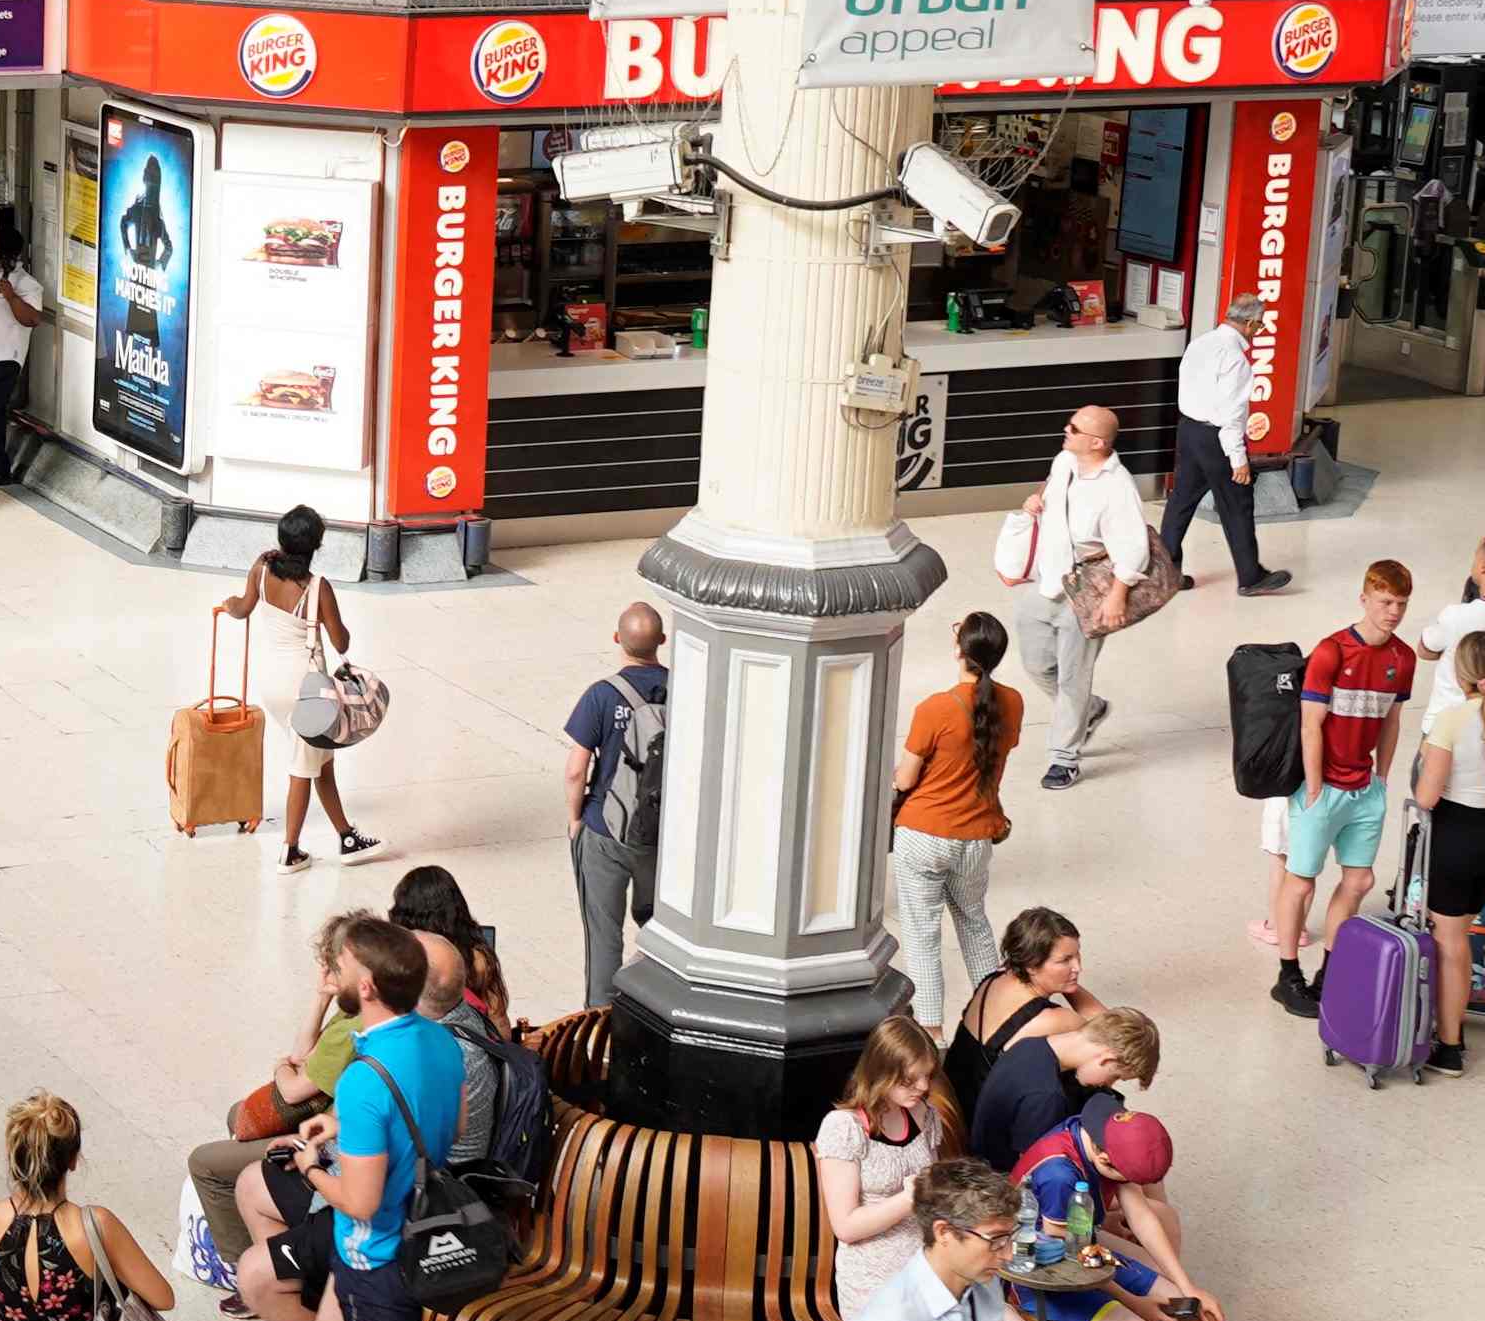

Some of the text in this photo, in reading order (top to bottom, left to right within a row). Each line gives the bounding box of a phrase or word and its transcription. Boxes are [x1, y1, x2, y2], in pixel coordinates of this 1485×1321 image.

[249, 33, 305, 59] BURGER
[839, 18, 995, 62] appeal
[250, 46, 306, 79] KING
[427, 186, 467, 457] BURGER KING
[114, 330, 170, 392] Matilda
